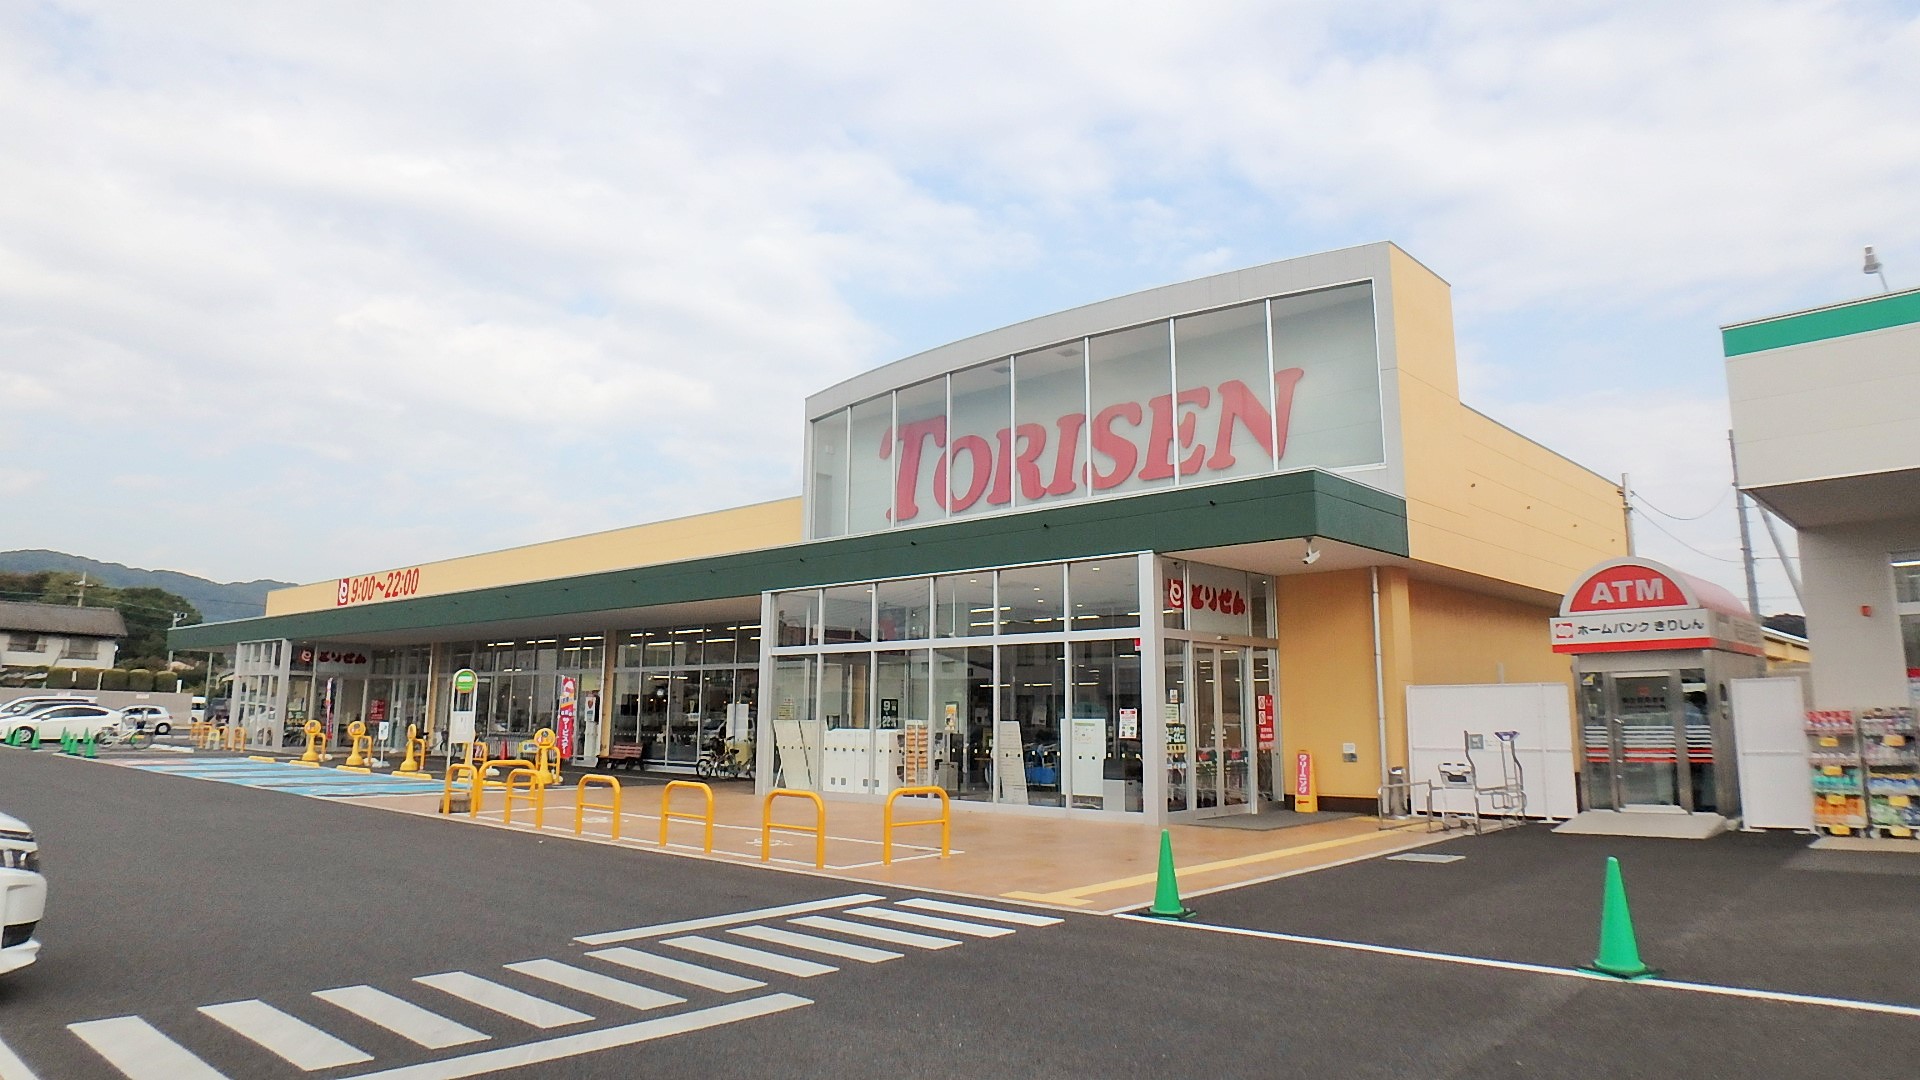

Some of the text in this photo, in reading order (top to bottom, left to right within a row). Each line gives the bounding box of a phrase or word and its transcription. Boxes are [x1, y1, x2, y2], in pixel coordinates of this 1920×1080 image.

[879, 367, 1304, 521] TORISEN
[1191, 584, 1246, 616] とりせん
[1590, 578, 1665, 604] ATM
[1577, 619, 1704, 636] ホームバンク きりしん
[1298, 754, 1308, 794] クリーニング
